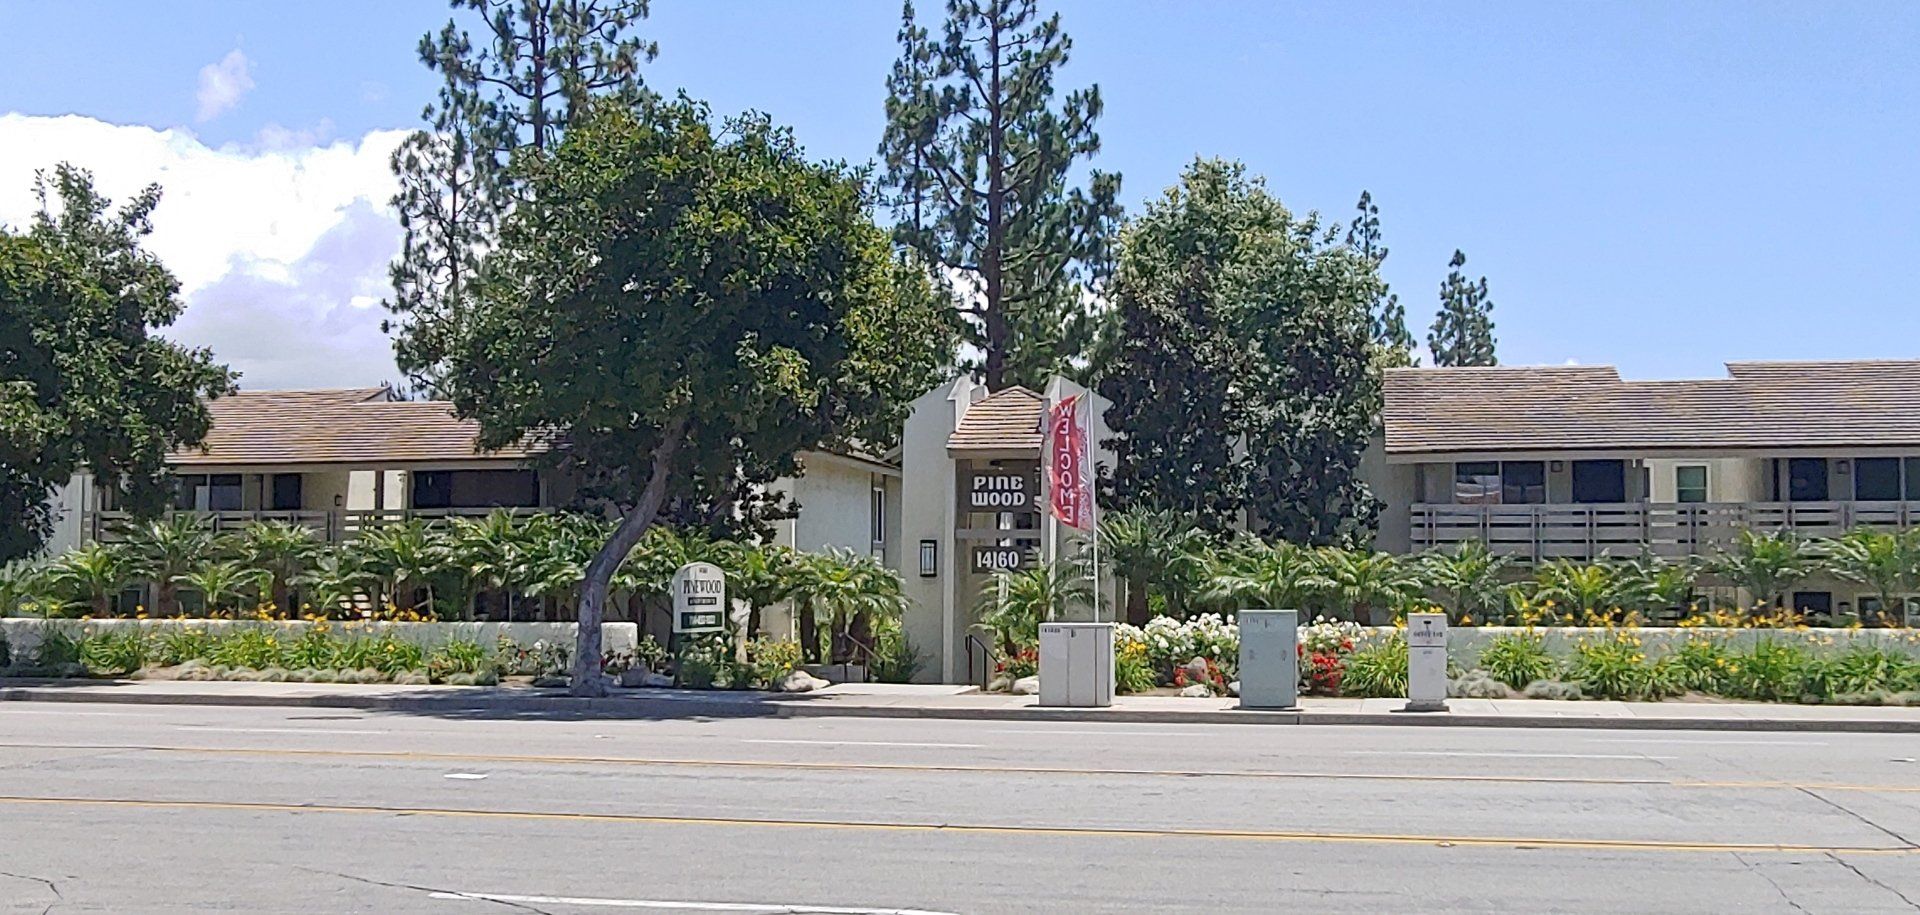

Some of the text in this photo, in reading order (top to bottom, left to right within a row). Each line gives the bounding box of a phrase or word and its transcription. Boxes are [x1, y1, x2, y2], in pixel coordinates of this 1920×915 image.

[973, 476, 1024, 490] PINE
[971, 492, 1026, 506] WOOD
[976, 551, 1019, 569] 14160
[683, 580, 722, 594] PINEWOOD
